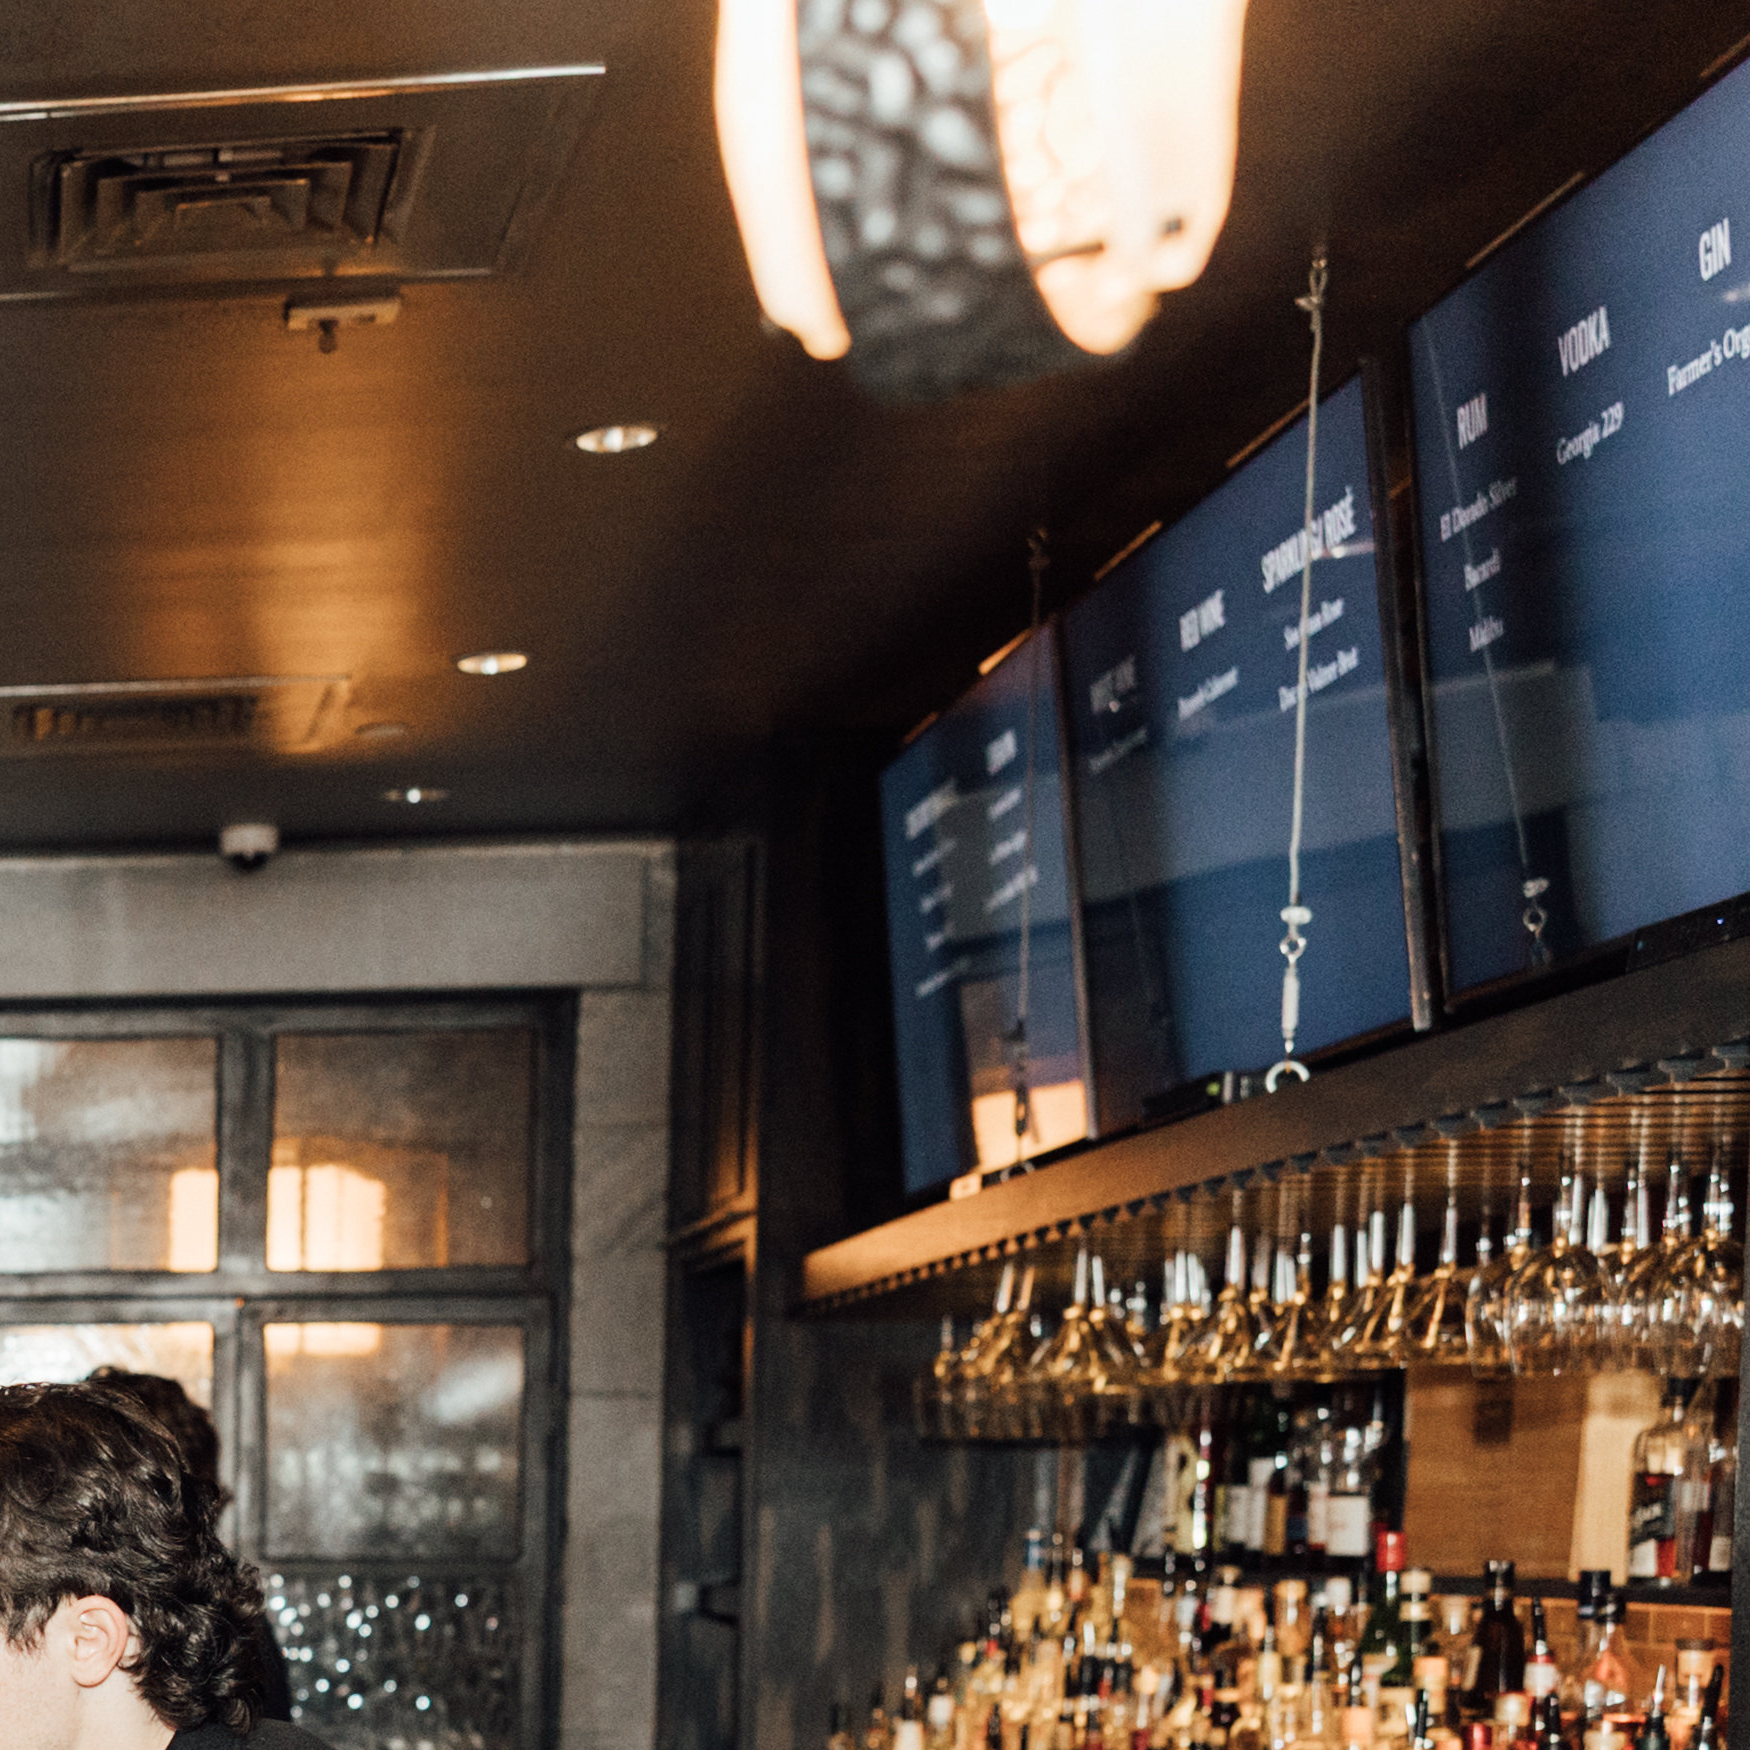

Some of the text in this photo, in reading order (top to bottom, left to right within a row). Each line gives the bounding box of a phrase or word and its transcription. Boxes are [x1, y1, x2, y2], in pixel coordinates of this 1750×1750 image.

[1699, 217, 1731, 282] GIN
[1557, 306, 1611, 377] VODKA
[1667, 339, 1723, 397] Farmer's
[1457, 392, 1488, 450] RUM
[1557, 401, 1624, 465] Georgia 229
